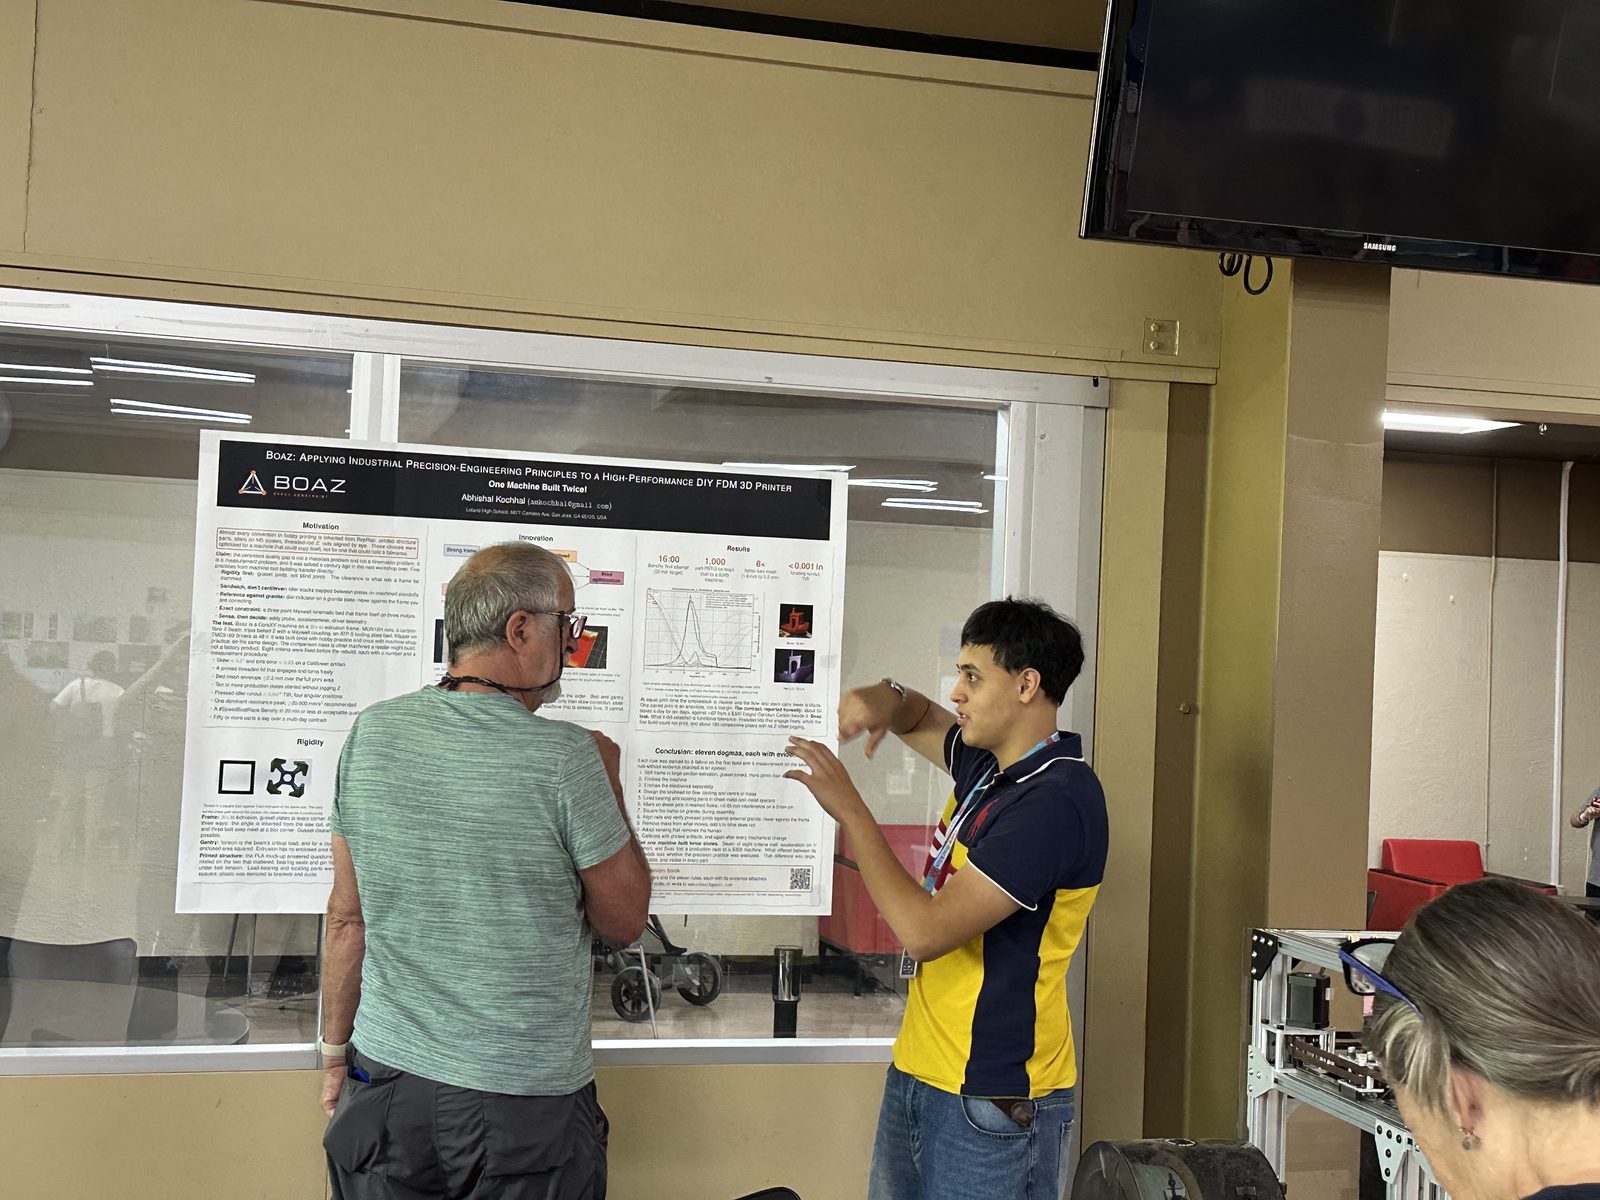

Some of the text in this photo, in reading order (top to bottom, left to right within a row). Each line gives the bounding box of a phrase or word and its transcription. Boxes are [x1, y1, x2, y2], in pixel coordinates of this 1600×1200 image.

[1364, 242, 1396, 252] SAMSUNG
[266, 450, 296, 461] BOAZ:
[299, 452, 346, 464] APPLYING
[348, 456, 403, 468] INDUSTRIAL
[406, 460, 522, 476] PRECISION-ENGINEERING
[525, 468, 578, 482] PRINCIPLES
[580, 473, 592, 481] TO
[603, 472, 694, 487] HIGH-PERFORMANCE
[696, 478, 714, 488] DIY
[716, 480, 738, 489] FDM
[740, 481, 752, 490] 3D
[756, 482, 792, 492] PRINTER
[274, 476, 346, 493] BOAZ
[488, 480, 505, 488] One
[507, 481, 540, 491] Machine
[542, 483, 560, 492] Built
[496, 496, 526, 505] Kochhal
[303, 522, 340, 530] Motivation
[519, 534, 554, 542] Innovation
[297, 738, 324, 746] Rigidity
